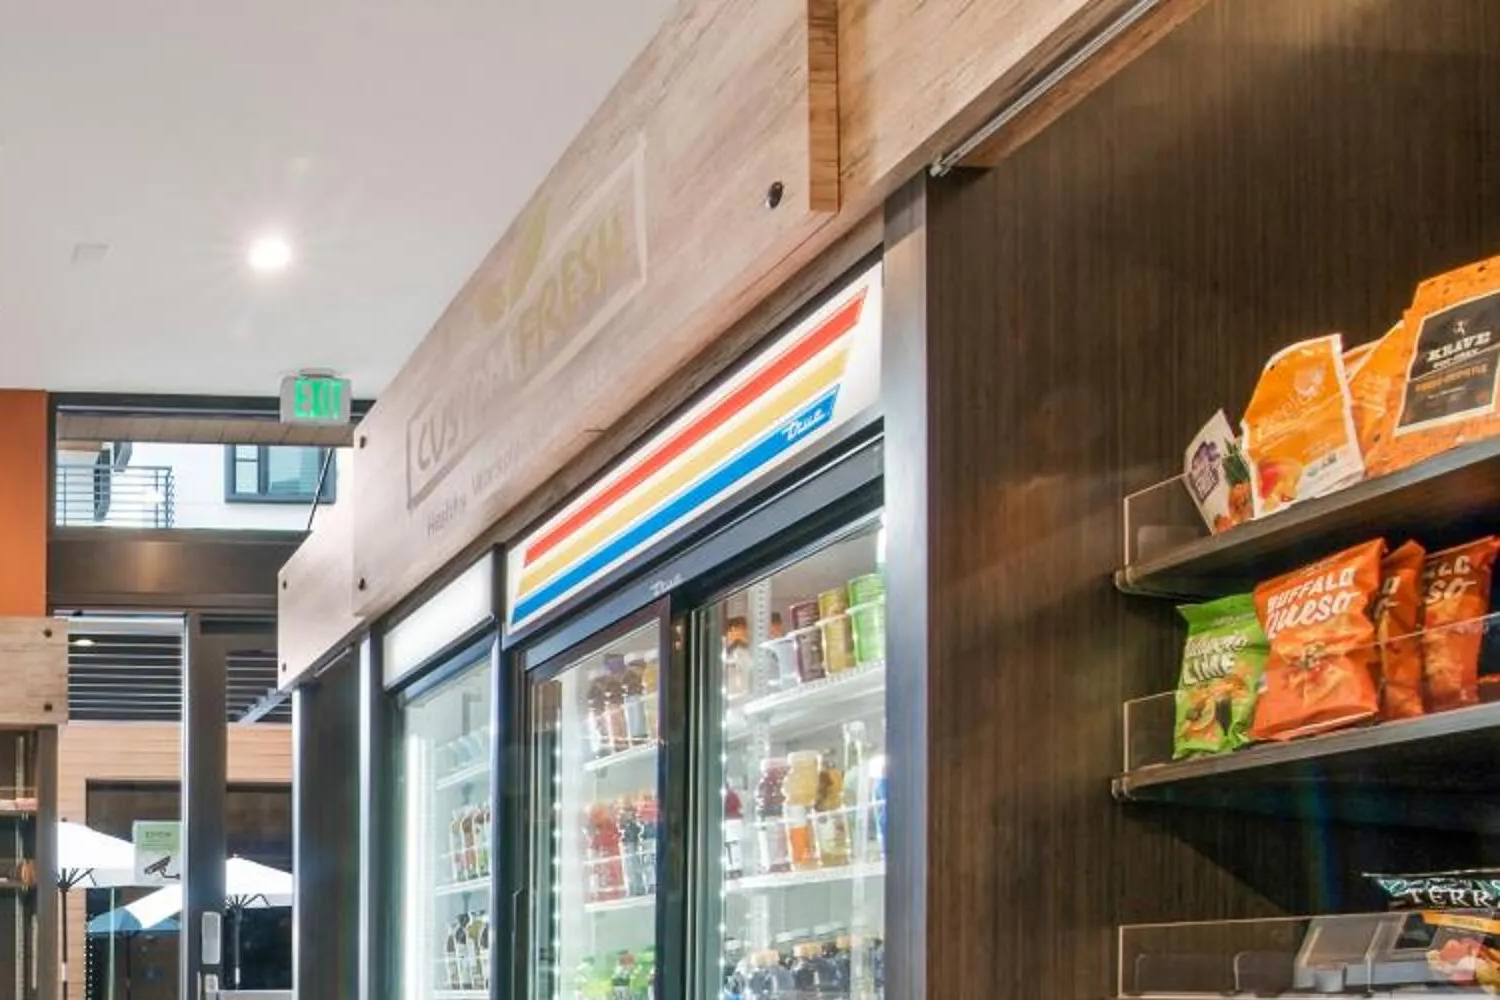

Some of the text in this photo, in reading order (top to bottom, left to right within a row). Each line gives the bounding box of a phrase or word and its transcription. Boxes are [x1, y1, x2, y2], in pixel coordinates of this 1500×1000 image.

[519, 207, 624, 372] FRESH
[294, 379, 341, 418] EXIT
[1266, 566, 1357, 613] BUFFALO
[1405, 886, 1500, 911] TERR
